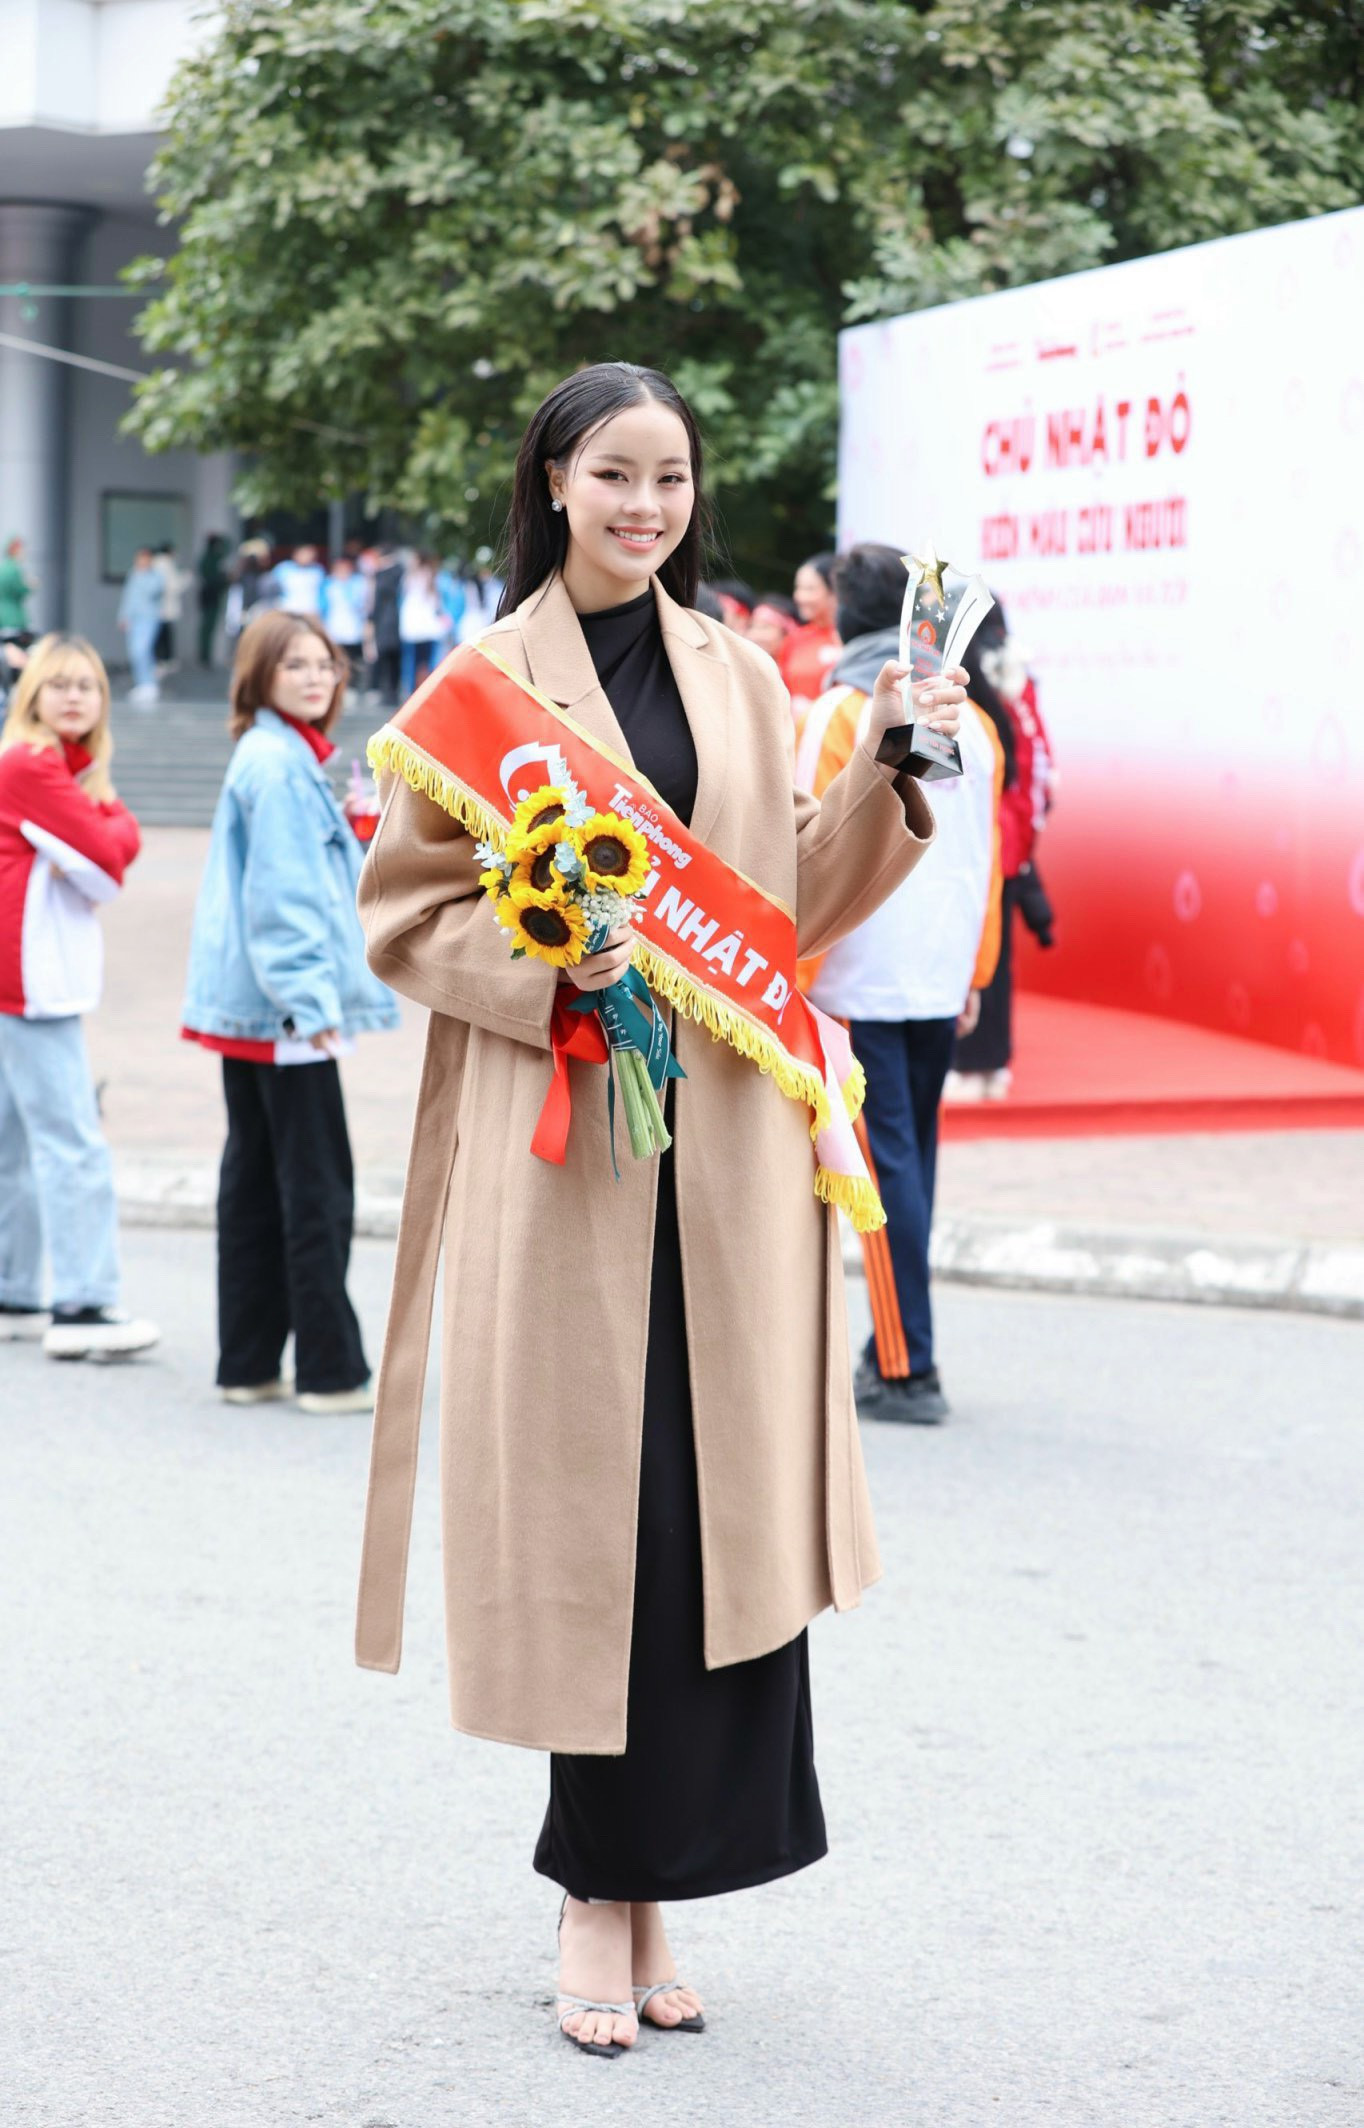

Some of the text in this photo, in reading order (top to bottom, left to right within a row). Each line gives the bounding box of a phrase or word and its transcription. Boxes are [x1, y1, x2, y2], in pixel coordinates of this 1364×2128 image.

[638, 803, 659, 823] BÁO
[653, 885, 793, 1026] NHẬT Đ
